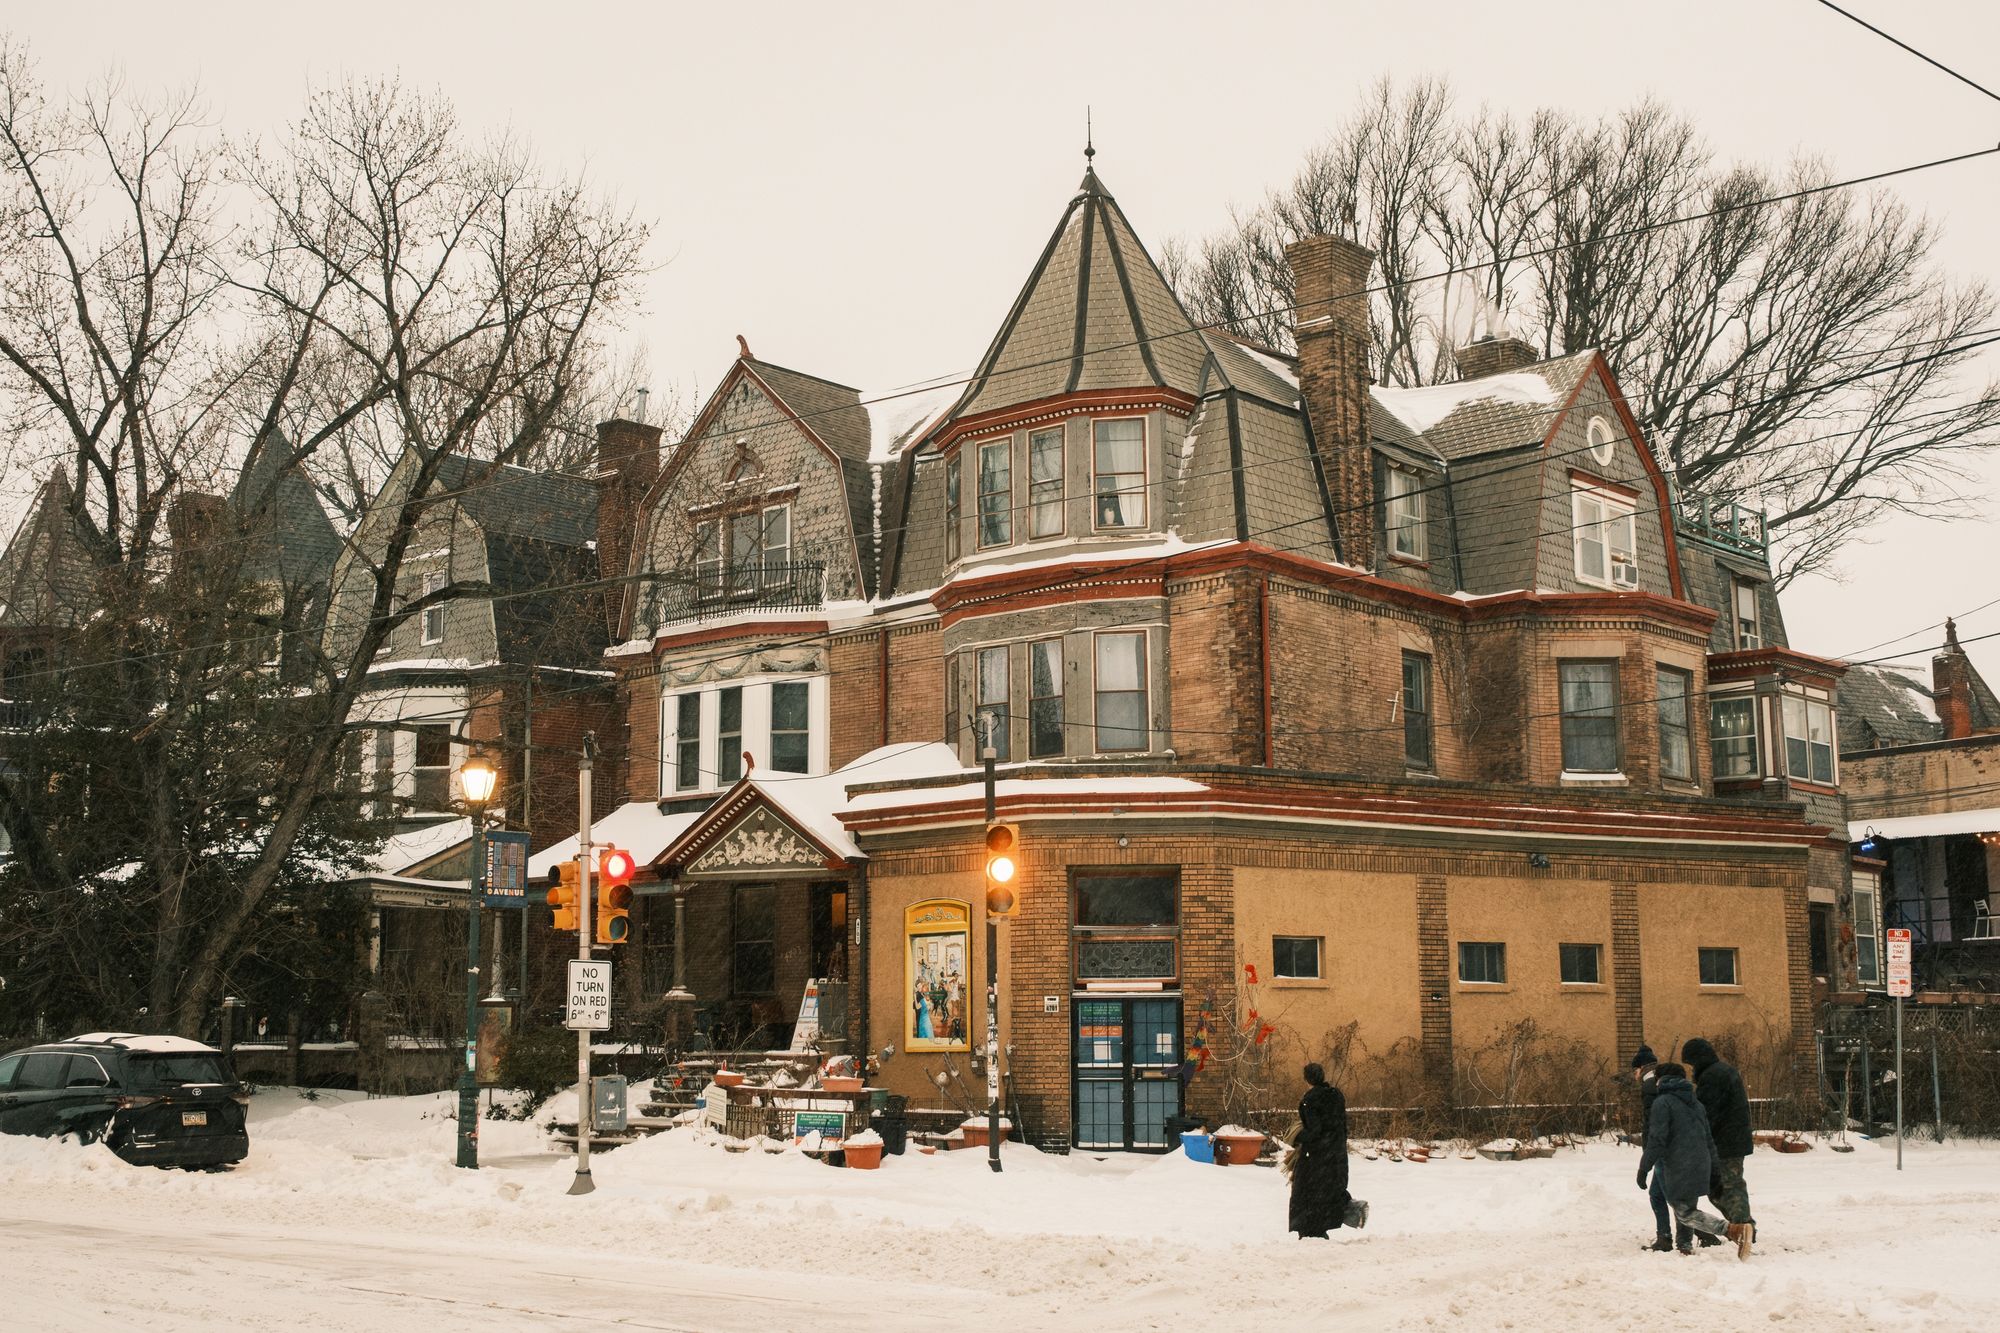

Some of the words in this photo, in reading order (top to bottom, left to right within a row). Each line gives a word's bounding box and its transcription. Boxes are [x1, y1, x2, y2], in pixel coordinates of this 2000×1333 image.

[493, 888, 525, 897] AVENUE
[582, 967, 599, 979] NO
[576, 981, 604, 992] TURN
[572, 995, 586, 1006] ON
[589, 996, 607, 1007] RED
